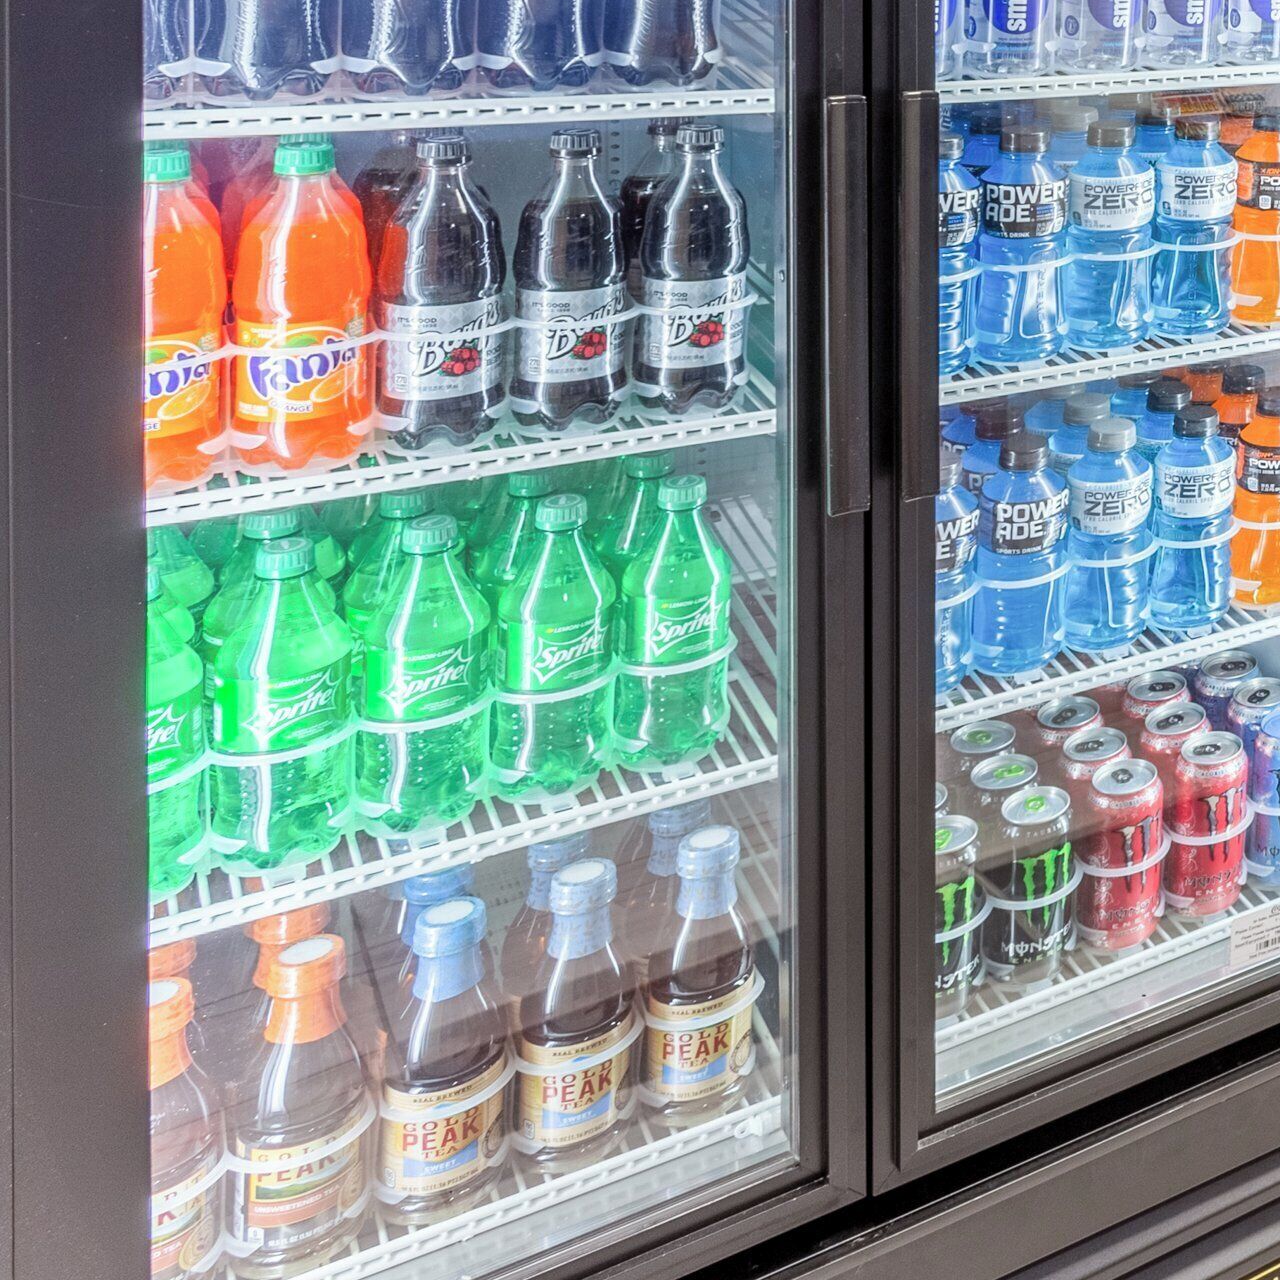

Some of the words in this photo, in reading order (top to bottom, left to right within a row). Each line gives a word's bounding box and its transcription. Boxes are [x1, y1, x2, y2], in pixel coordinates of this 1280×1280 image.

[986, 182, 1066, 205] POWER
[1084, 187, 1154, 210] ZERO
[1174, 180, 1237, 200] ZERO
[247, 338, 357, 400] Fanta
[1163, 476, 1232, 499] ZERO
[996, 488, 1070, 524] POWER
[1083, 488, 1150, 517] ZERO
[652, 610, 717, 642] Sprite
[534, 632, 602, 670] Sprite
[394, 662, 466, 701] Sprite
[256, 688, 334, 727] Sprite
[663, 1022, 730, 1043] GOLD
[662, 1033, 729, 1062] PEAK
[542, 1059, 613, 1086] GOLD
[678, 1057, 710, 1068] TEA
[542, 1069, 612, 1105] PEAK
[680, 1071, 708, 1081] SWEET
[436, 1084, 473, 1100] BREWED
[560, 1096, 594, 1112] TEA
[404, 1106, 480, 1132] GOLD
[562, 1110, 593, 1125] SWEET
[402, 1116, 480, 1152] PEAK
[421, 1146, 459, 1160] TEA
[424, 1159, 457, 1172] SWEET
[254, 1194, 323, 1214] UNSWEETENED
